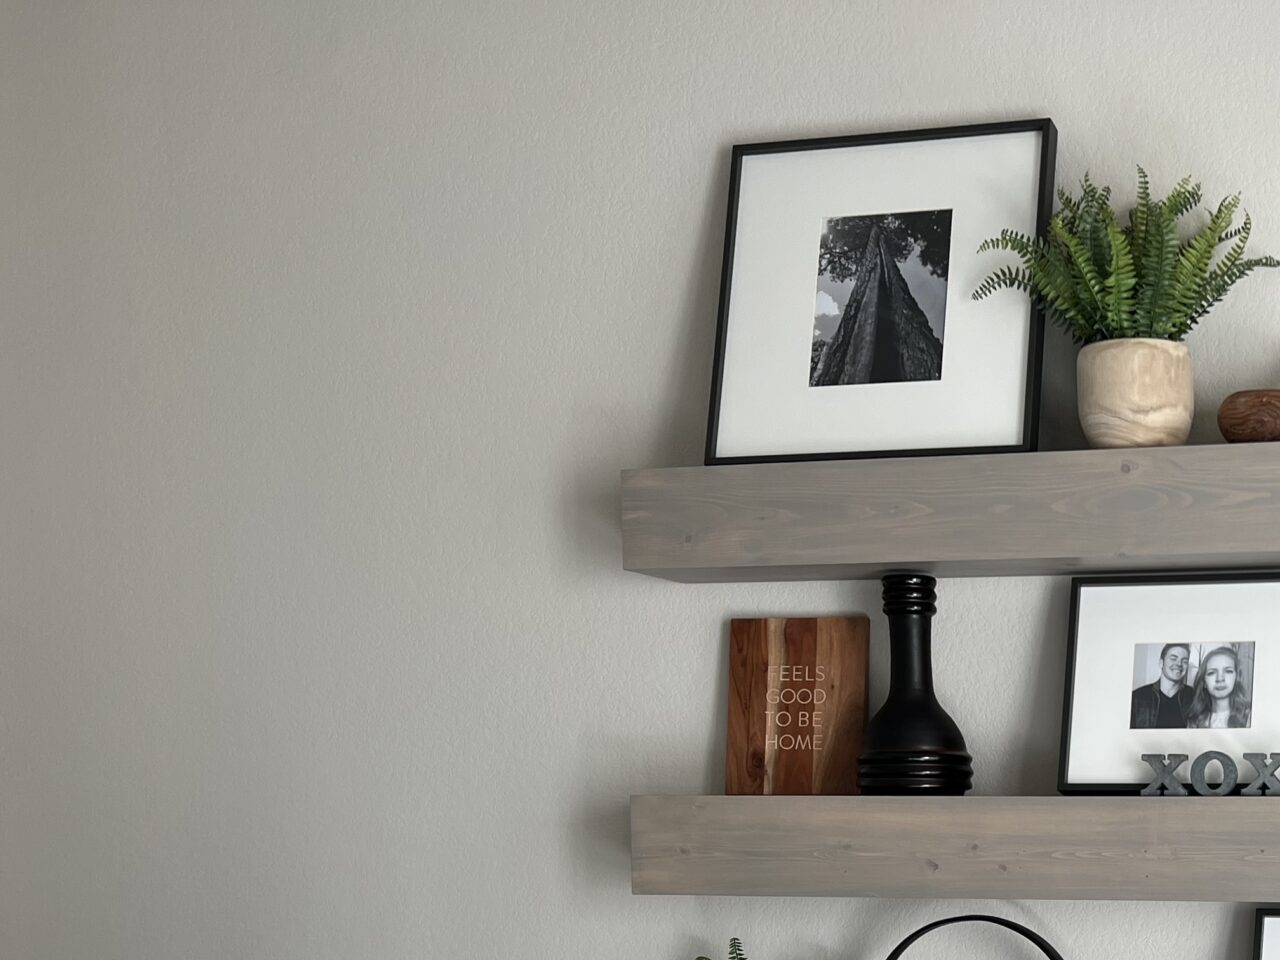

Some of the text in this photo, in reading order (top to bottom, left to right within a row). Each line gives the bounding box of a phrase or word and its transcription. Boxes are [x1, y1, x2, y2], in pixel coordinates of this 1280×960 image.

[767, 665, 825, 681] FEELS
[766, 688, 827, 704] GOOD
[765, 711, 823, 727] TO BE
[765, 734, 824, 750] HOME
